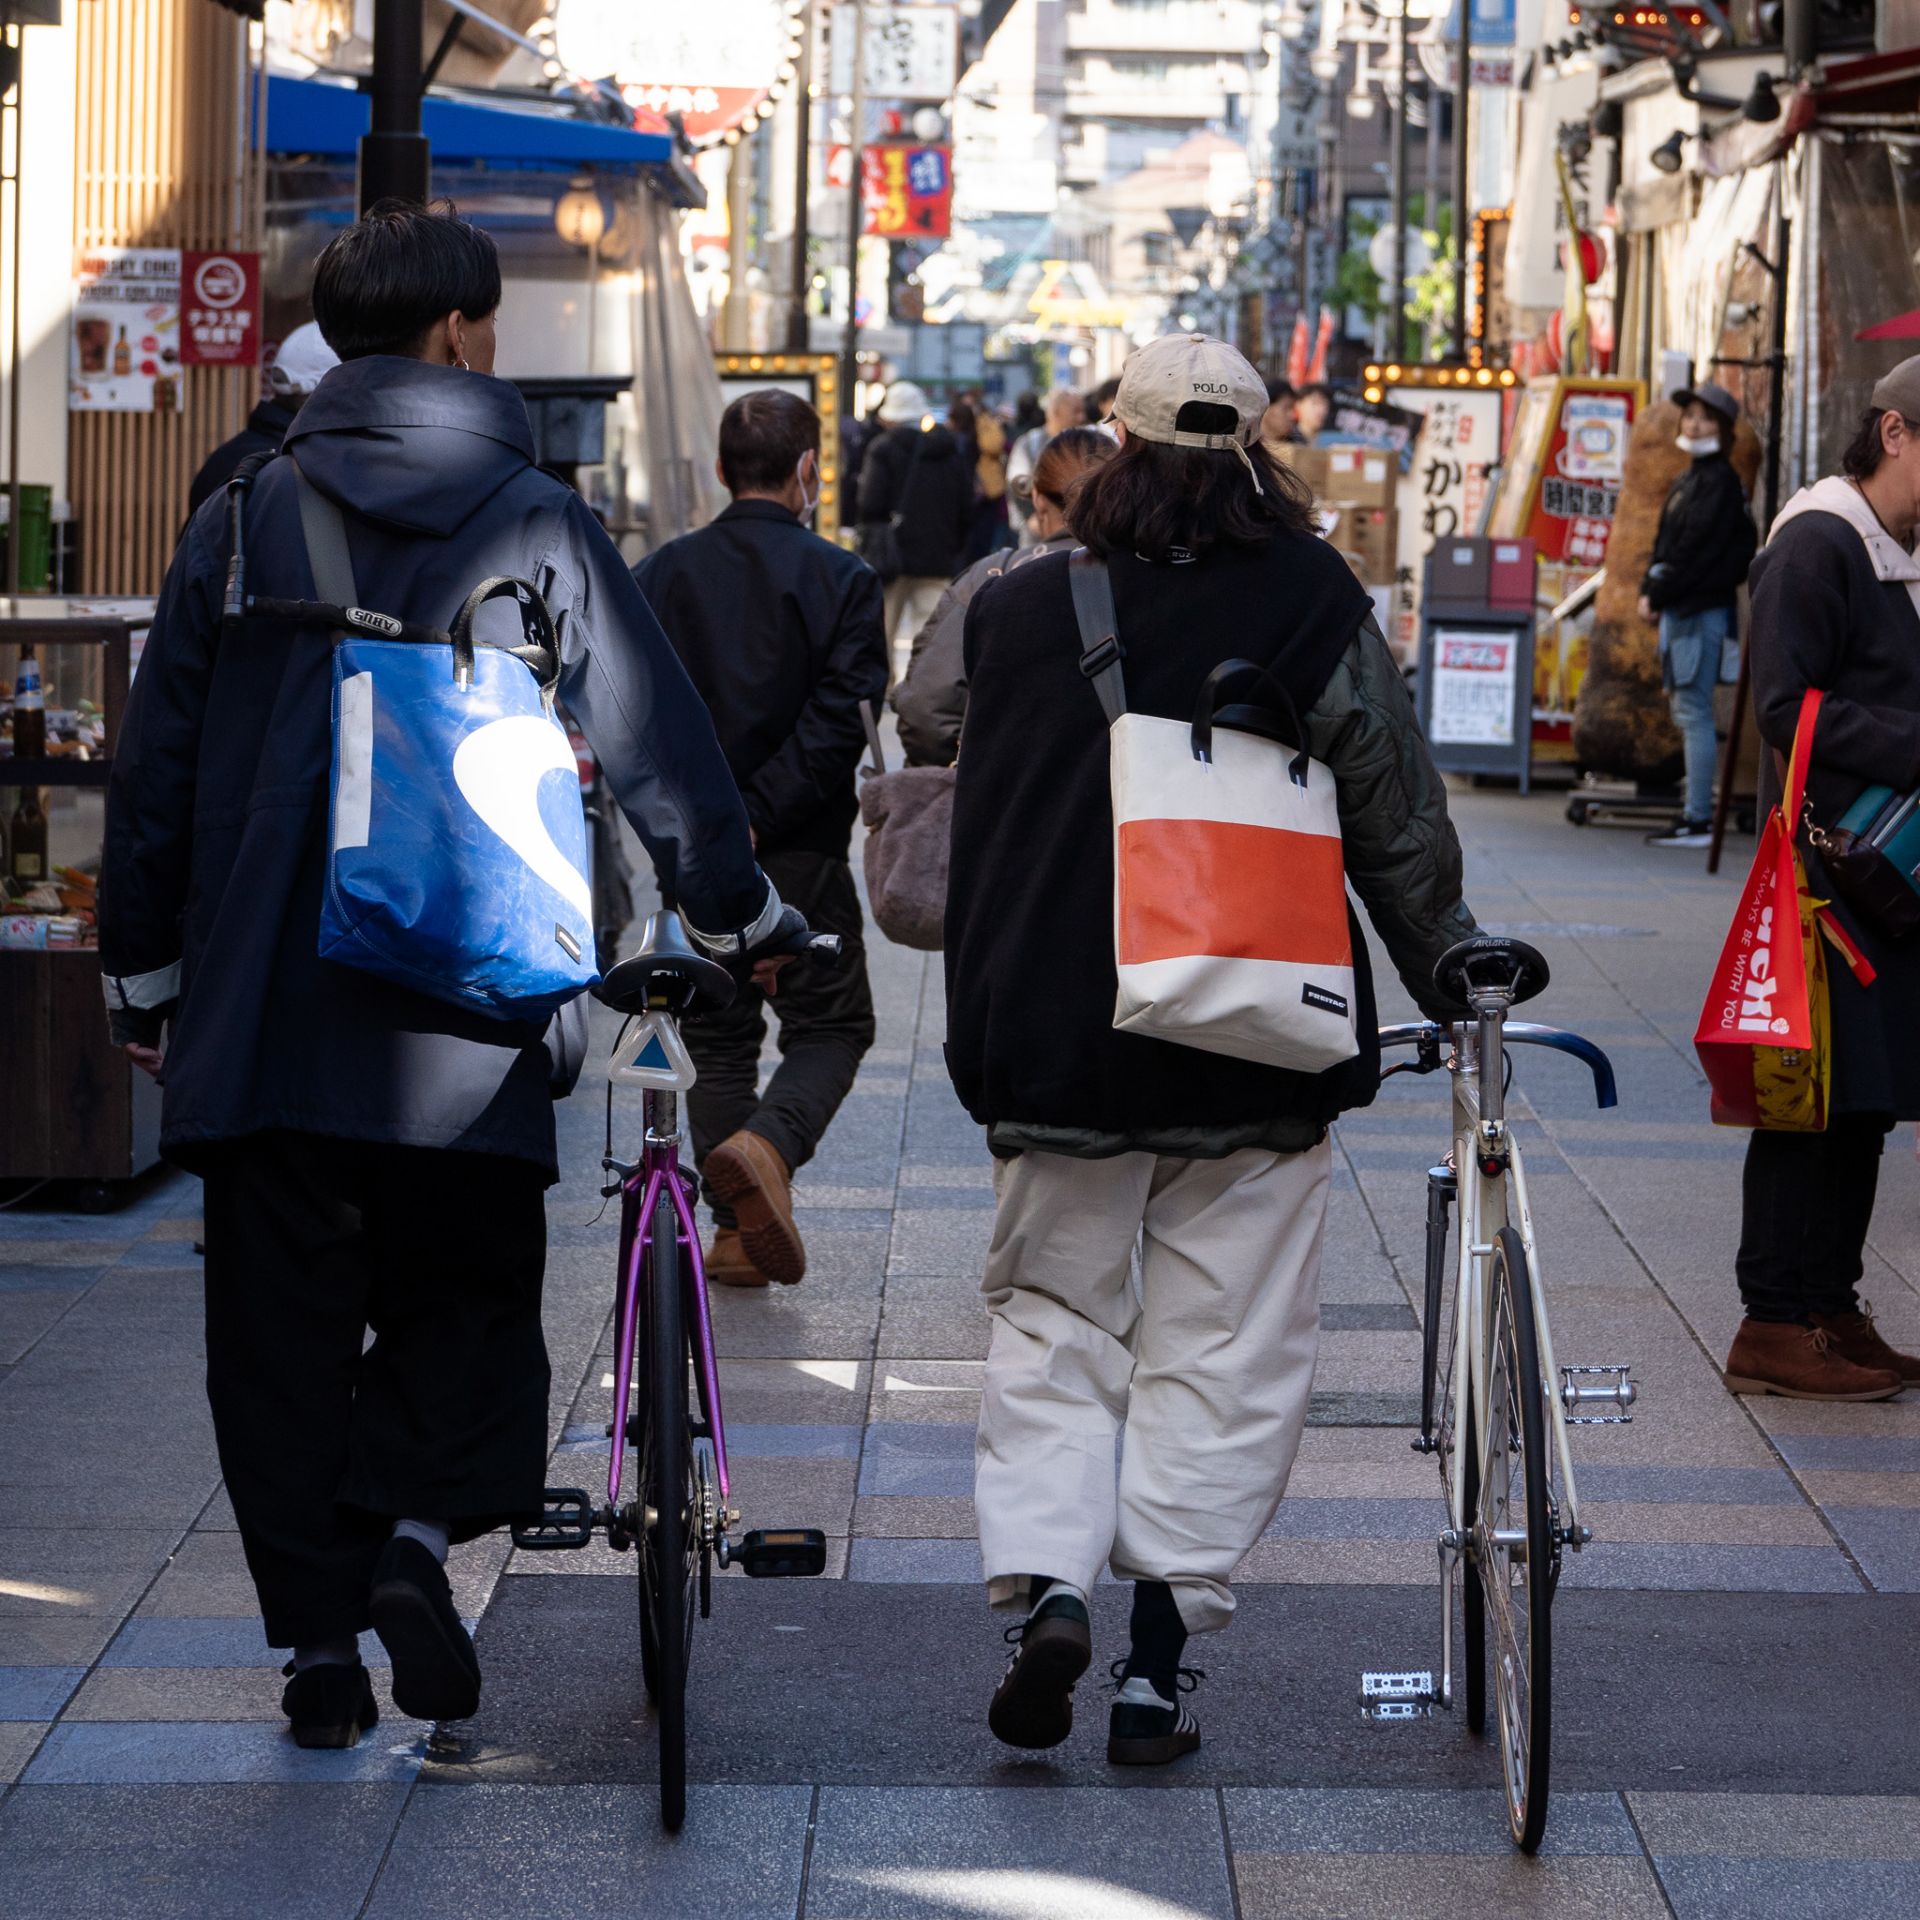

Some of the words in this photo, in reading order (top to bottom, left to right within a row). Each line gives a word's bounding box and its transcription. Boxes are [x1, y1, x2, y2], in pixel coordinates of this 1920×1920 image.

[1192, 383, 1229, 394] POLO
[355, 610, 395, 631] ABUS
[1748, 866, 1770, 923] ALWAYS
[1741, 928, 1753, 947] BE
[1729, 953, 1748, 993] WITH
[1308, 991, 1346, 1008] FREITAG
[1720, 999, 1738, 1030] YOU
